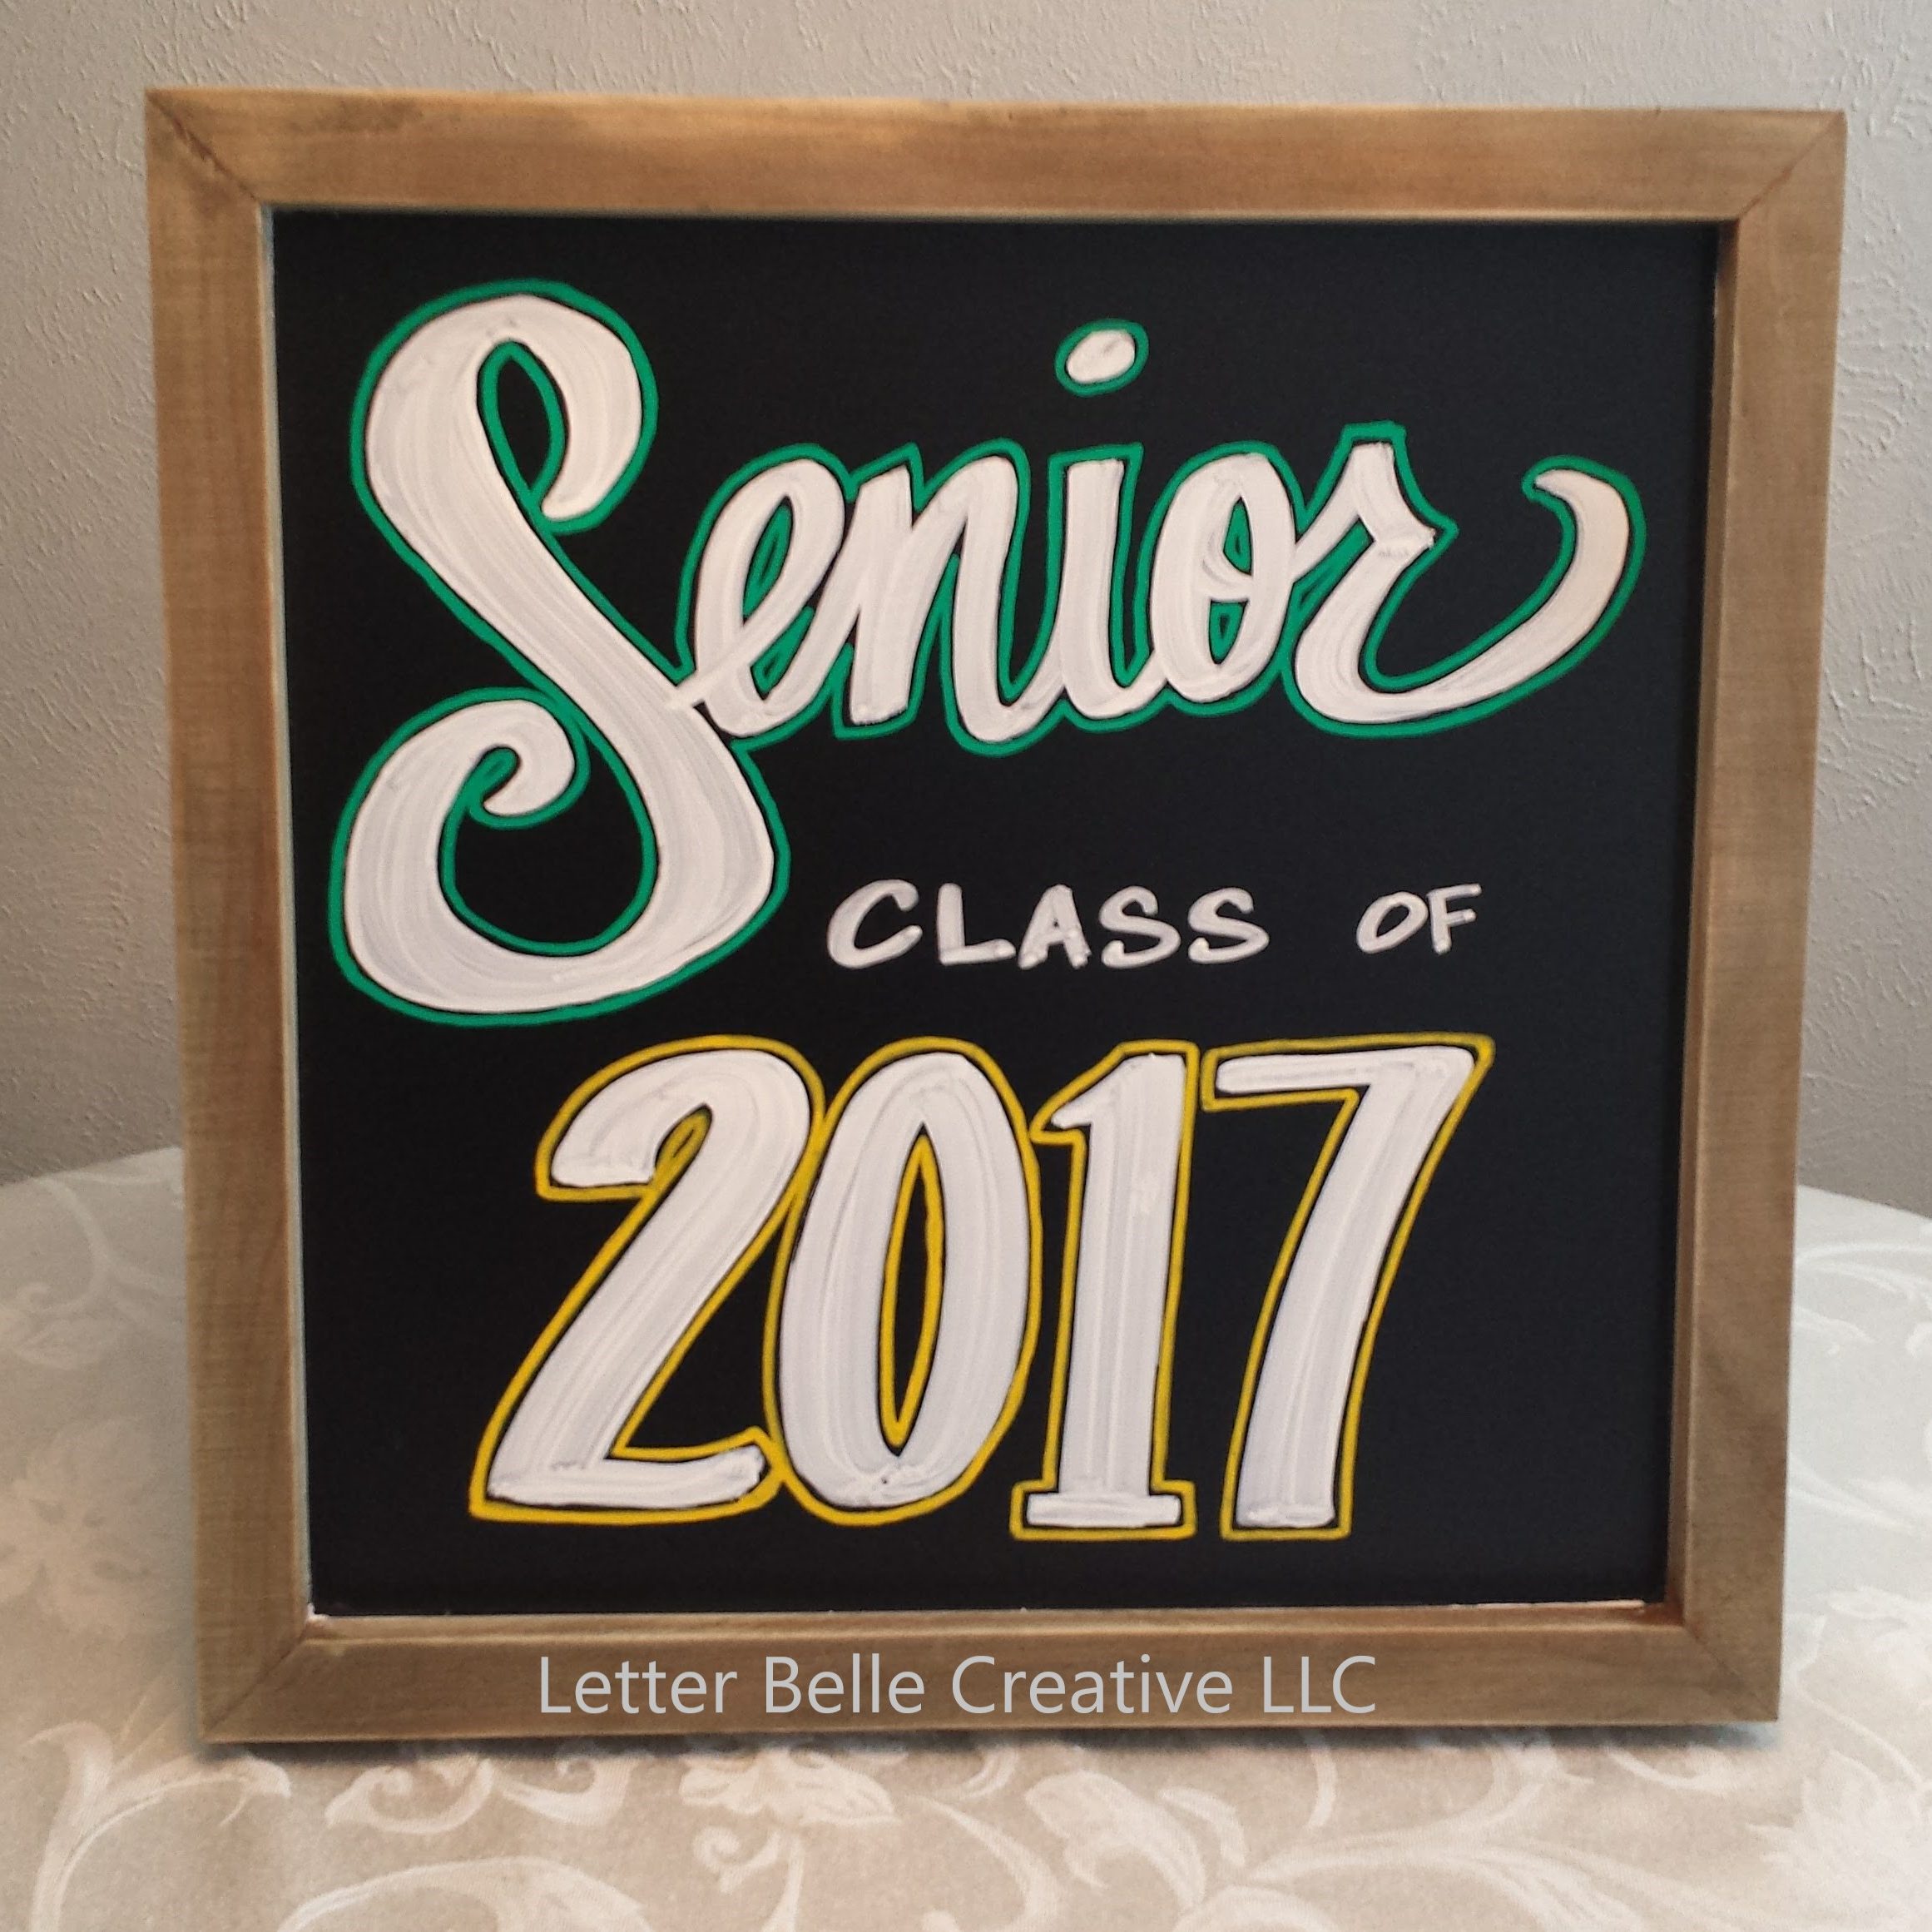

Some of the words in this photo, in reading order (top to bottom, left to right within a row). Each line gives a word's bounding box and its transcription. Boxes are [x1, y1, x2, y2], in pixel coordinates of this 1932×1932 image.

[329, 281, 1646, 1026] Senior
[826, 879, 1270, 969] CLASS
[1355, 883, 1482, 955] OF
[468, 1033, 1495, 1542] 2017
